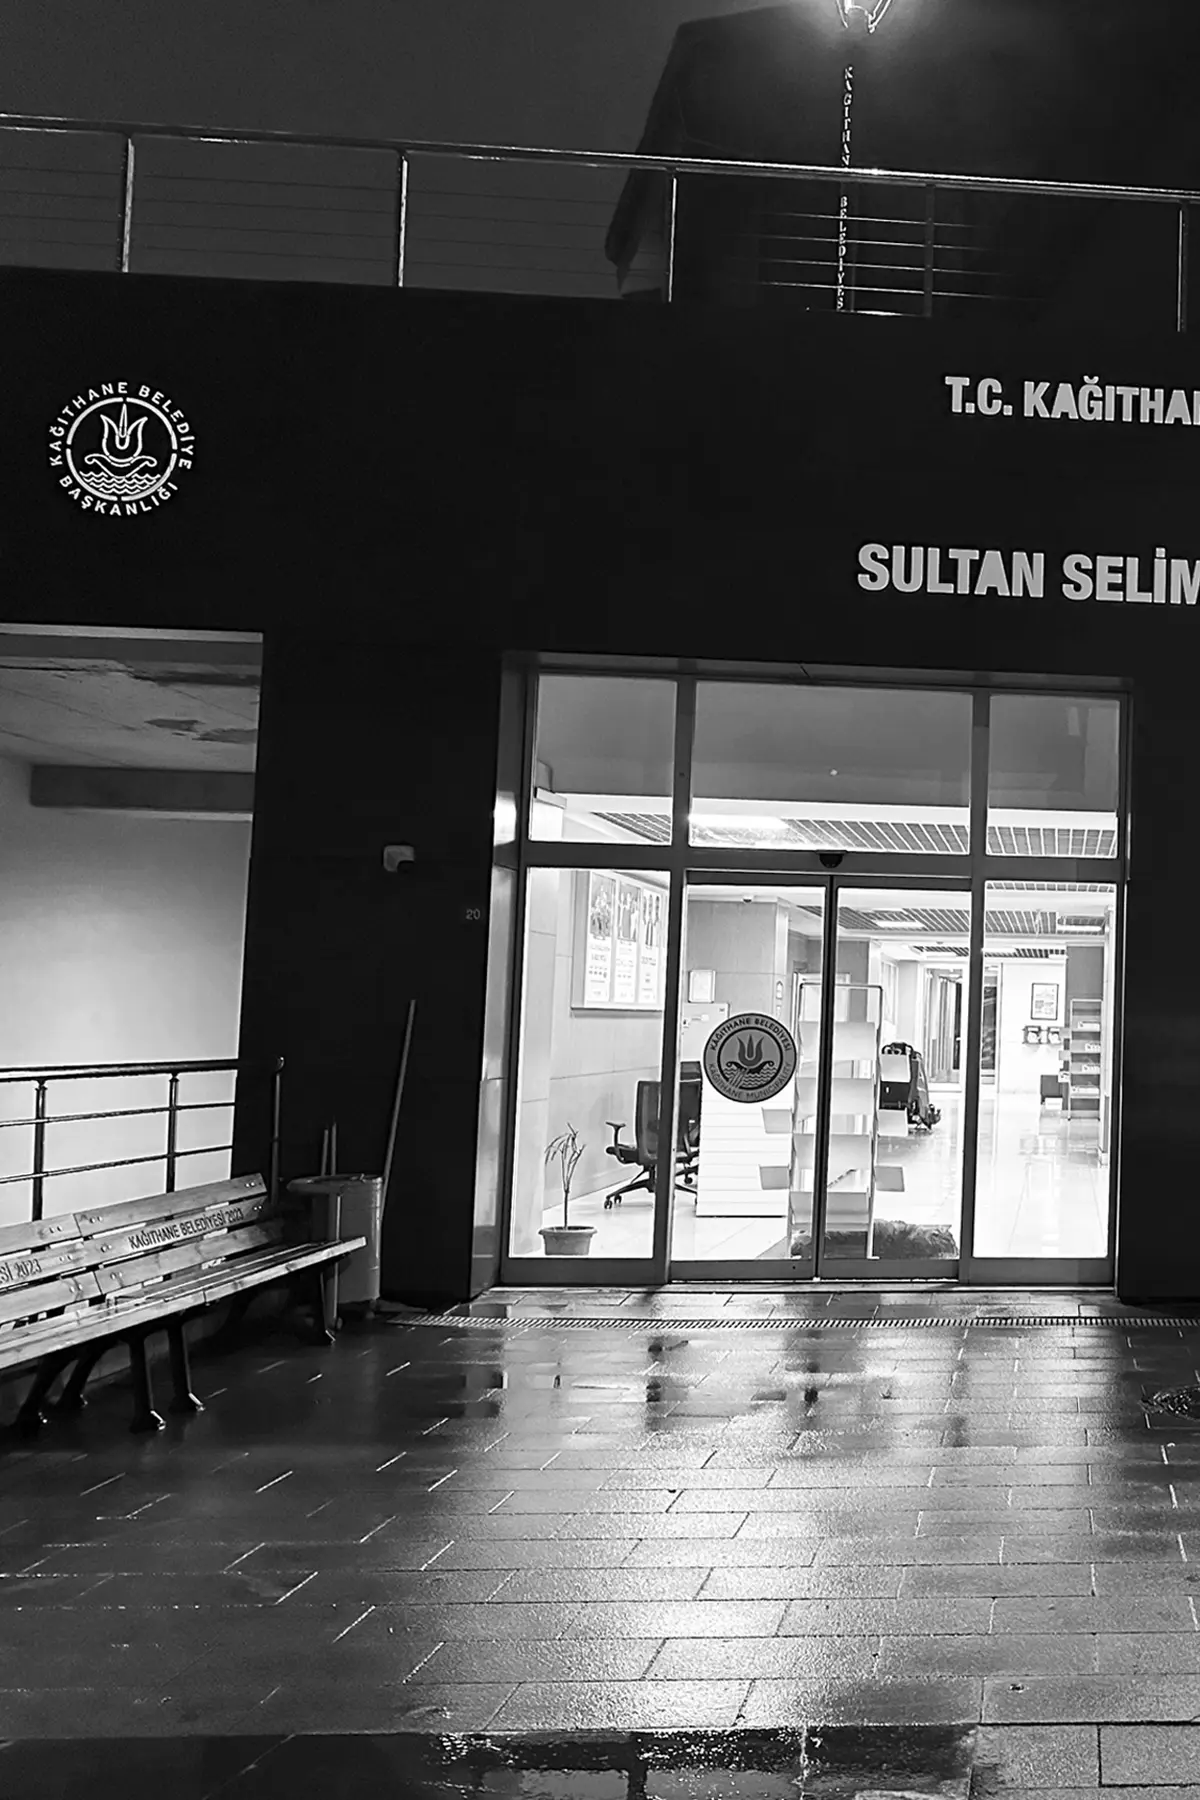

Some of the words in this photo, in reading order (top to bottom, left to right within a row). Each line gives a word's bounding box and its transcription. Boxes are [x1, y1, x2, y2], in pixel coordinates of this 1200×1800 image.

[944, 375, 1013, 417] T.C.
[49, 381, 128, 467] KAĞITHANE
[59, 476, 178, 516] BAŞKANLIĞI
[857, 543, 1045, 599] SULTAN
[465, 908, 481, 920] 20
[128, 1225, 180, 1249] KAĞITHANE
[180, 1210, 226, 1235] BELEDİYESİ
[225, 1208, 244, 1223] 2023
[14, 1258, 42, 1280] 2023
